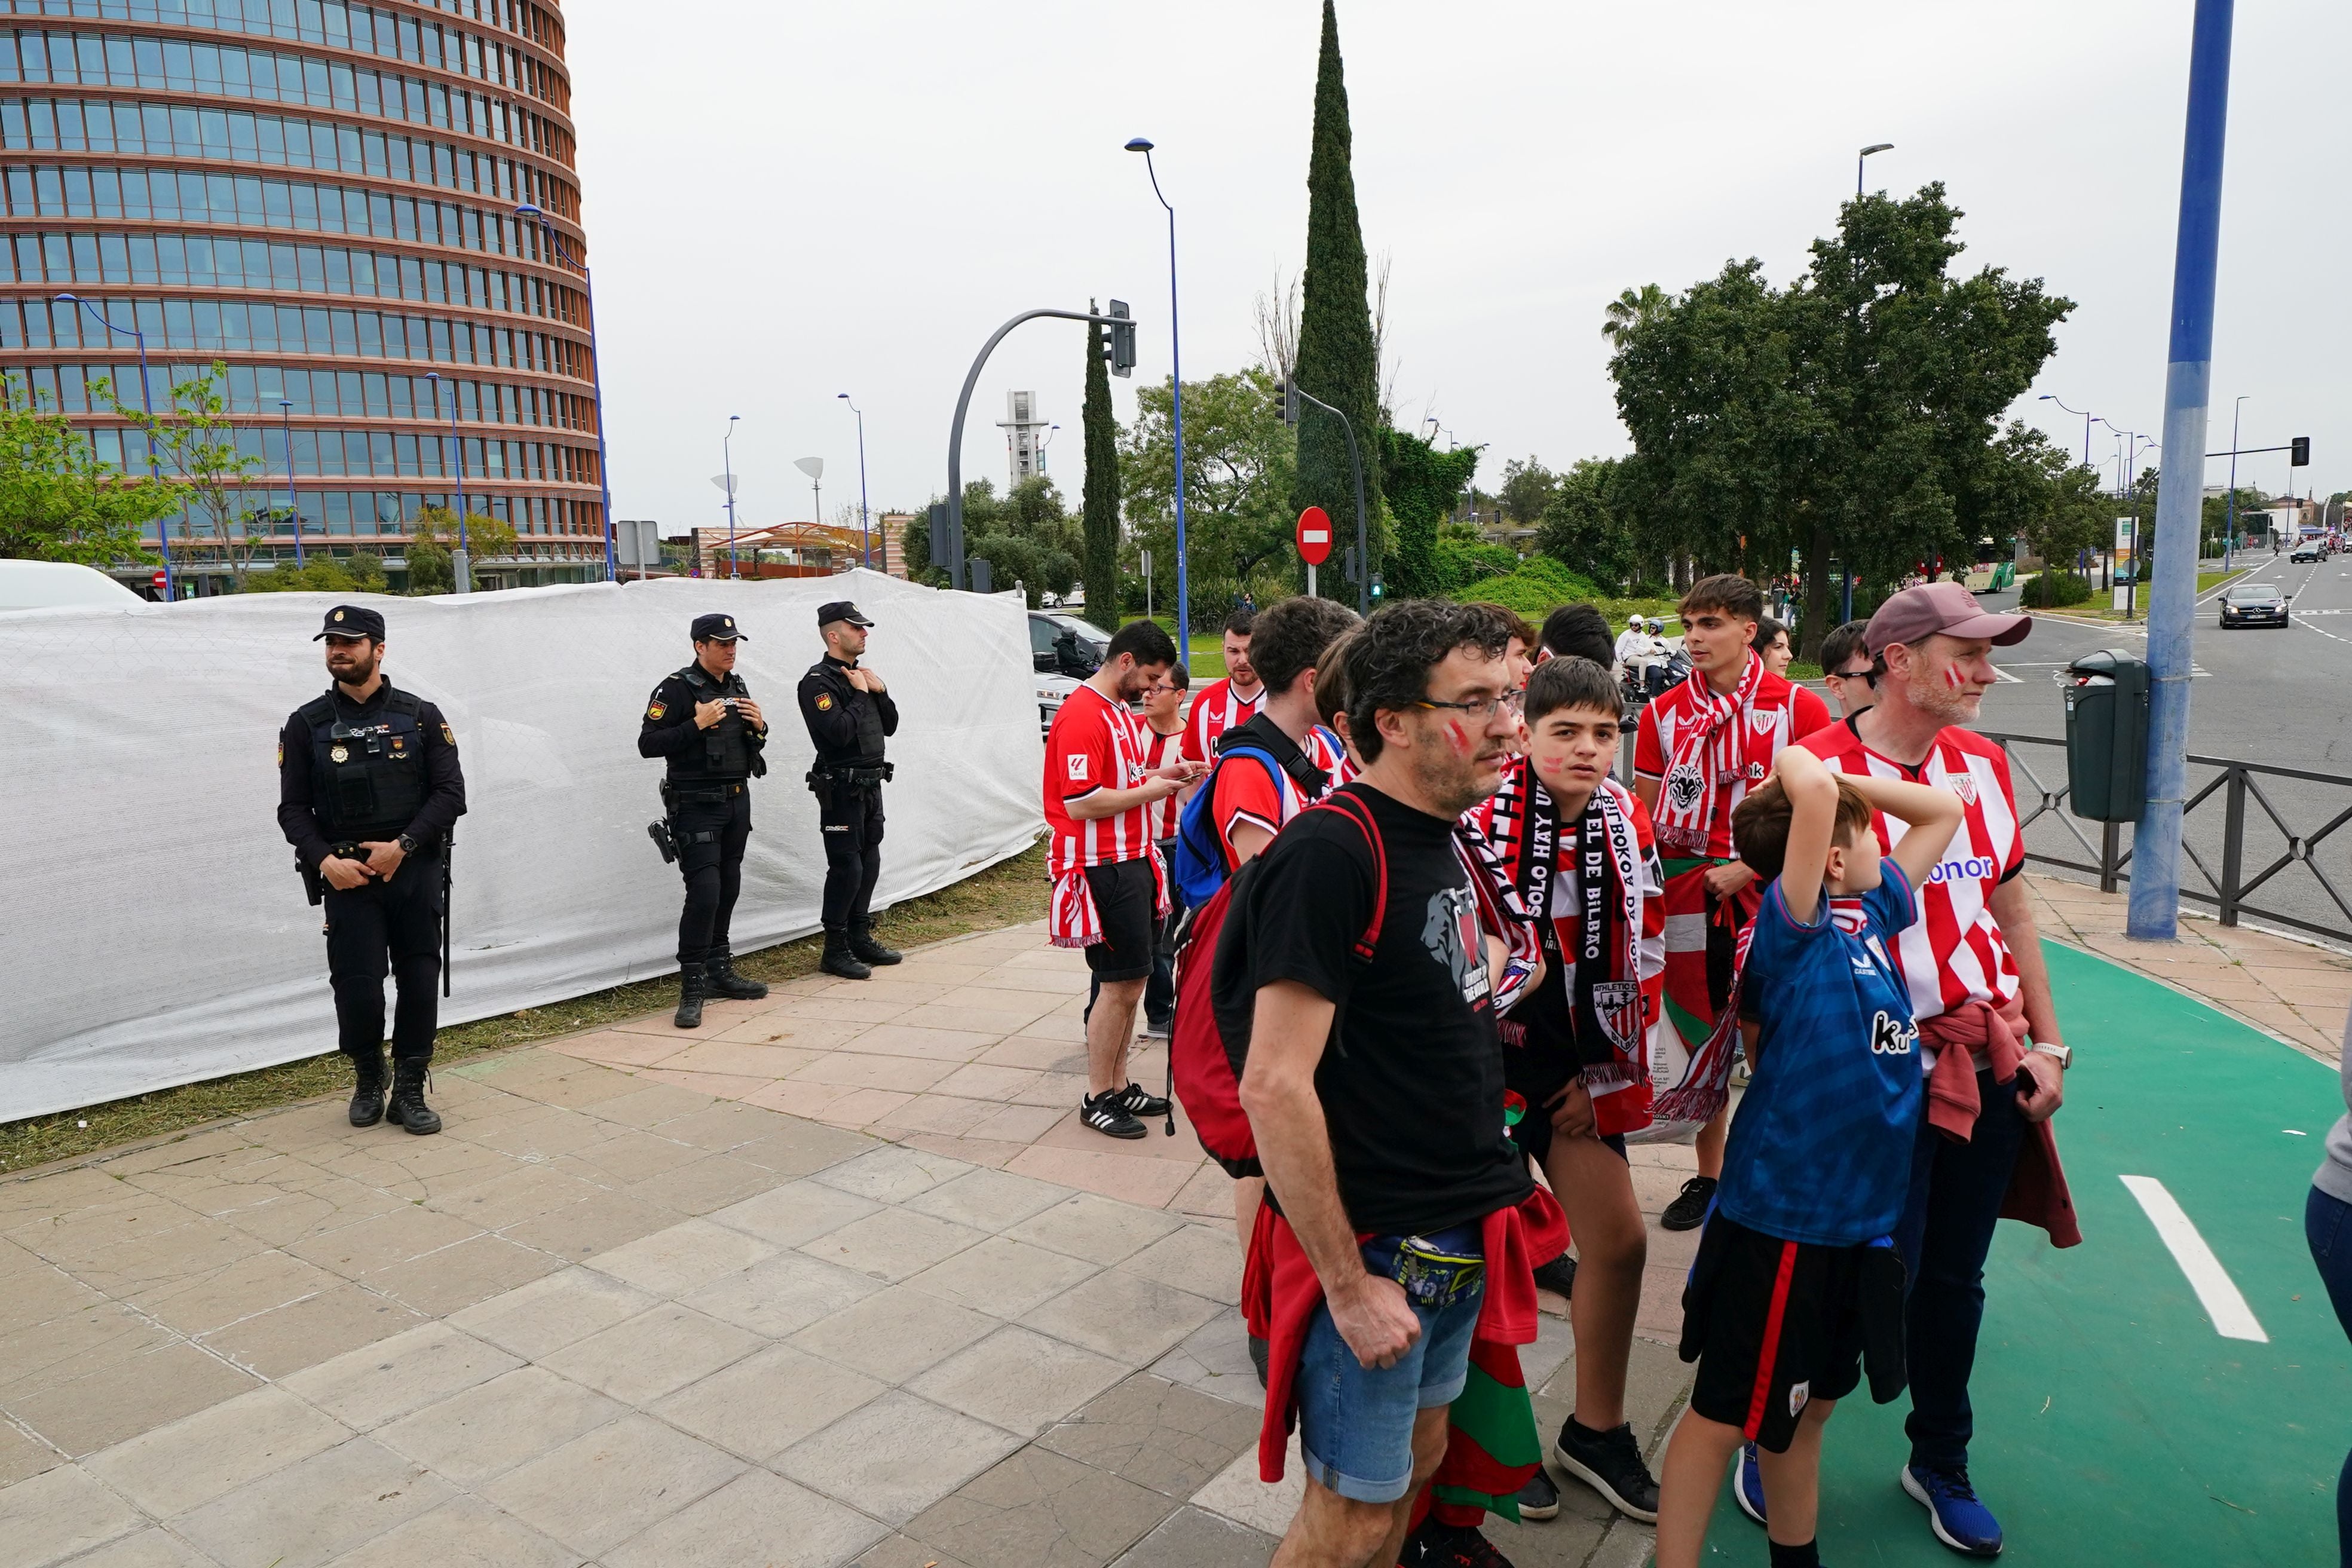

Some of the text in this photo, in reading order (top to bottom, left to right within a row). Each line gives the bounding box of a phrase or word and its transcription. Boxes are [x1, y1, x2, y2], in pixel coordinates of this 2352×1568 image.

[1533, 813, 1552, 859] HAY
[1586, 817, 1602, 844] EL
[1586, 852, 1602, 878] DE
[1930, 859, 1991, 881] onor
[1527, 866, 1547, 918] SOLO
[1594, 983, 1629, 991] ATHLETIC
